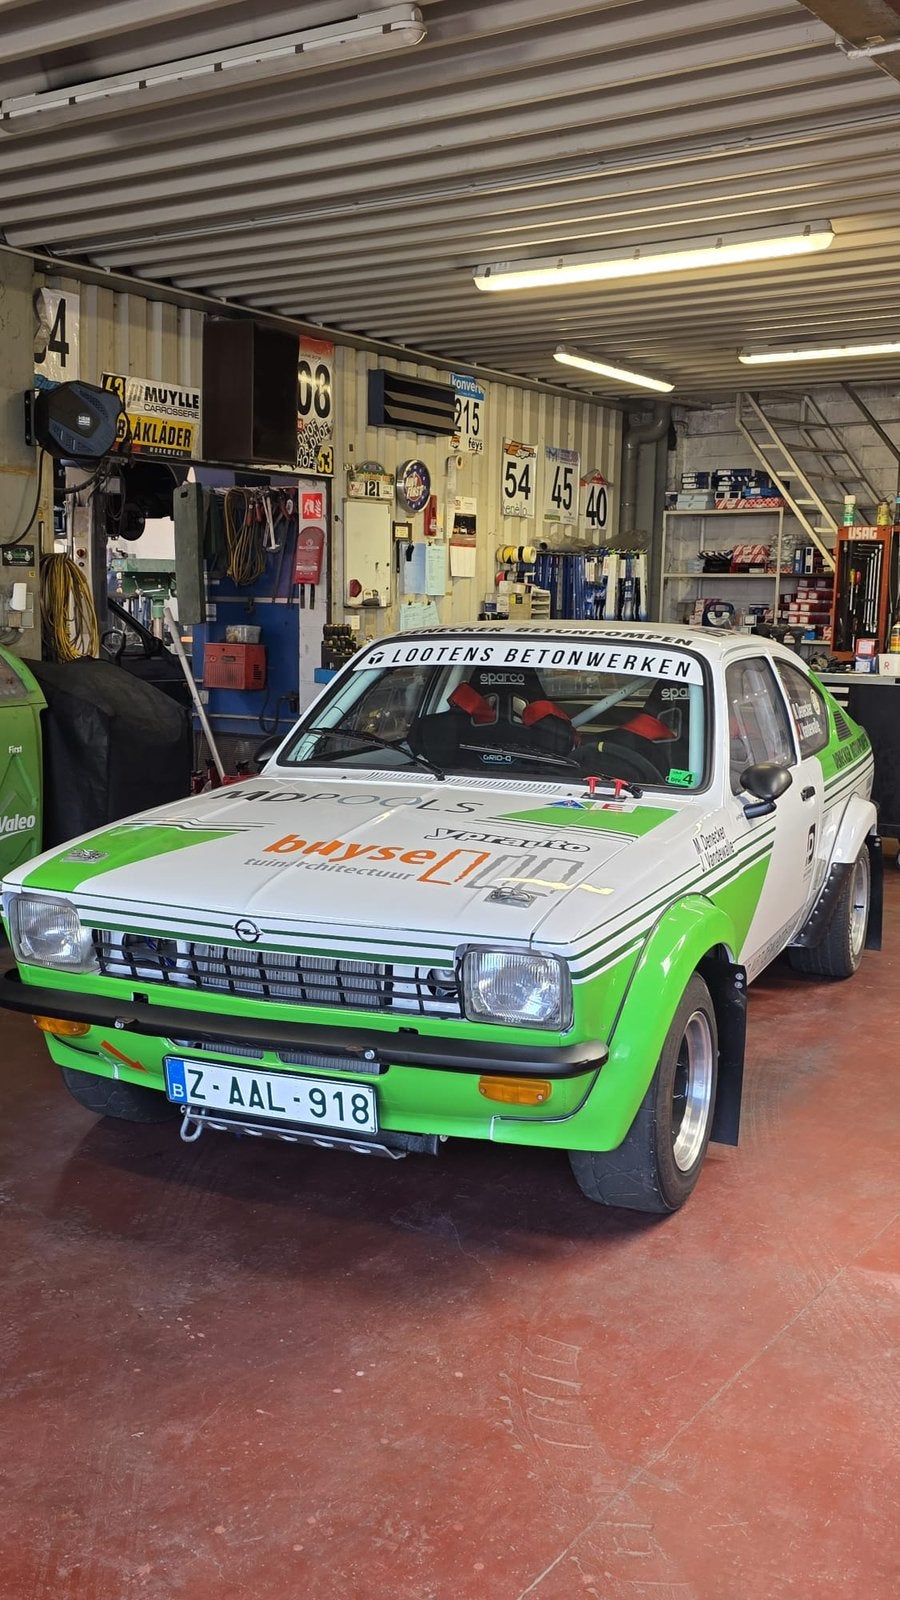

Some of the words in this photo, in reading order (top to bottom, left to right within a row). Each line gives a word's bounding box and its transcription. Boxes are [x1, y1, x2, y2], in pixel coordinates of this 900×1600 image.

[144, 386, 199, 409] MUYLLE
[144, 403, 200, 419] CARROSSERIE
[455, 398, 480, 436] 215
[468, 437, 483, 451] feys
[364, 479, 380, 497] 121
[505, 461, 531, 500] 54
[552, 466, 573, 511] 45
[586, 486, 607, 527] 40
[848, 527, 878, 540] USAG
[514, 626, 694, 647] BETONPOMPEN
[391, 647, 495, 663] LOOTENS
[503, 648, 692, 678] BETONWERKEN
[480, 672, 525, 686] sparco
[8, 745, 23, 754] First
[682, 773, 694, 785] 4
[209, 790, 484, 813] MDPOOLS
[0, 813, 36, 833] Valeo
[424, 828, 591, 852] yprauto
[700, 825, 727, 850] Denecker
[262, 834, 438, 865] buyse
[243, 858, 416, 881] tuinarchitectuur
[172, 1083, 184, 1098] B
